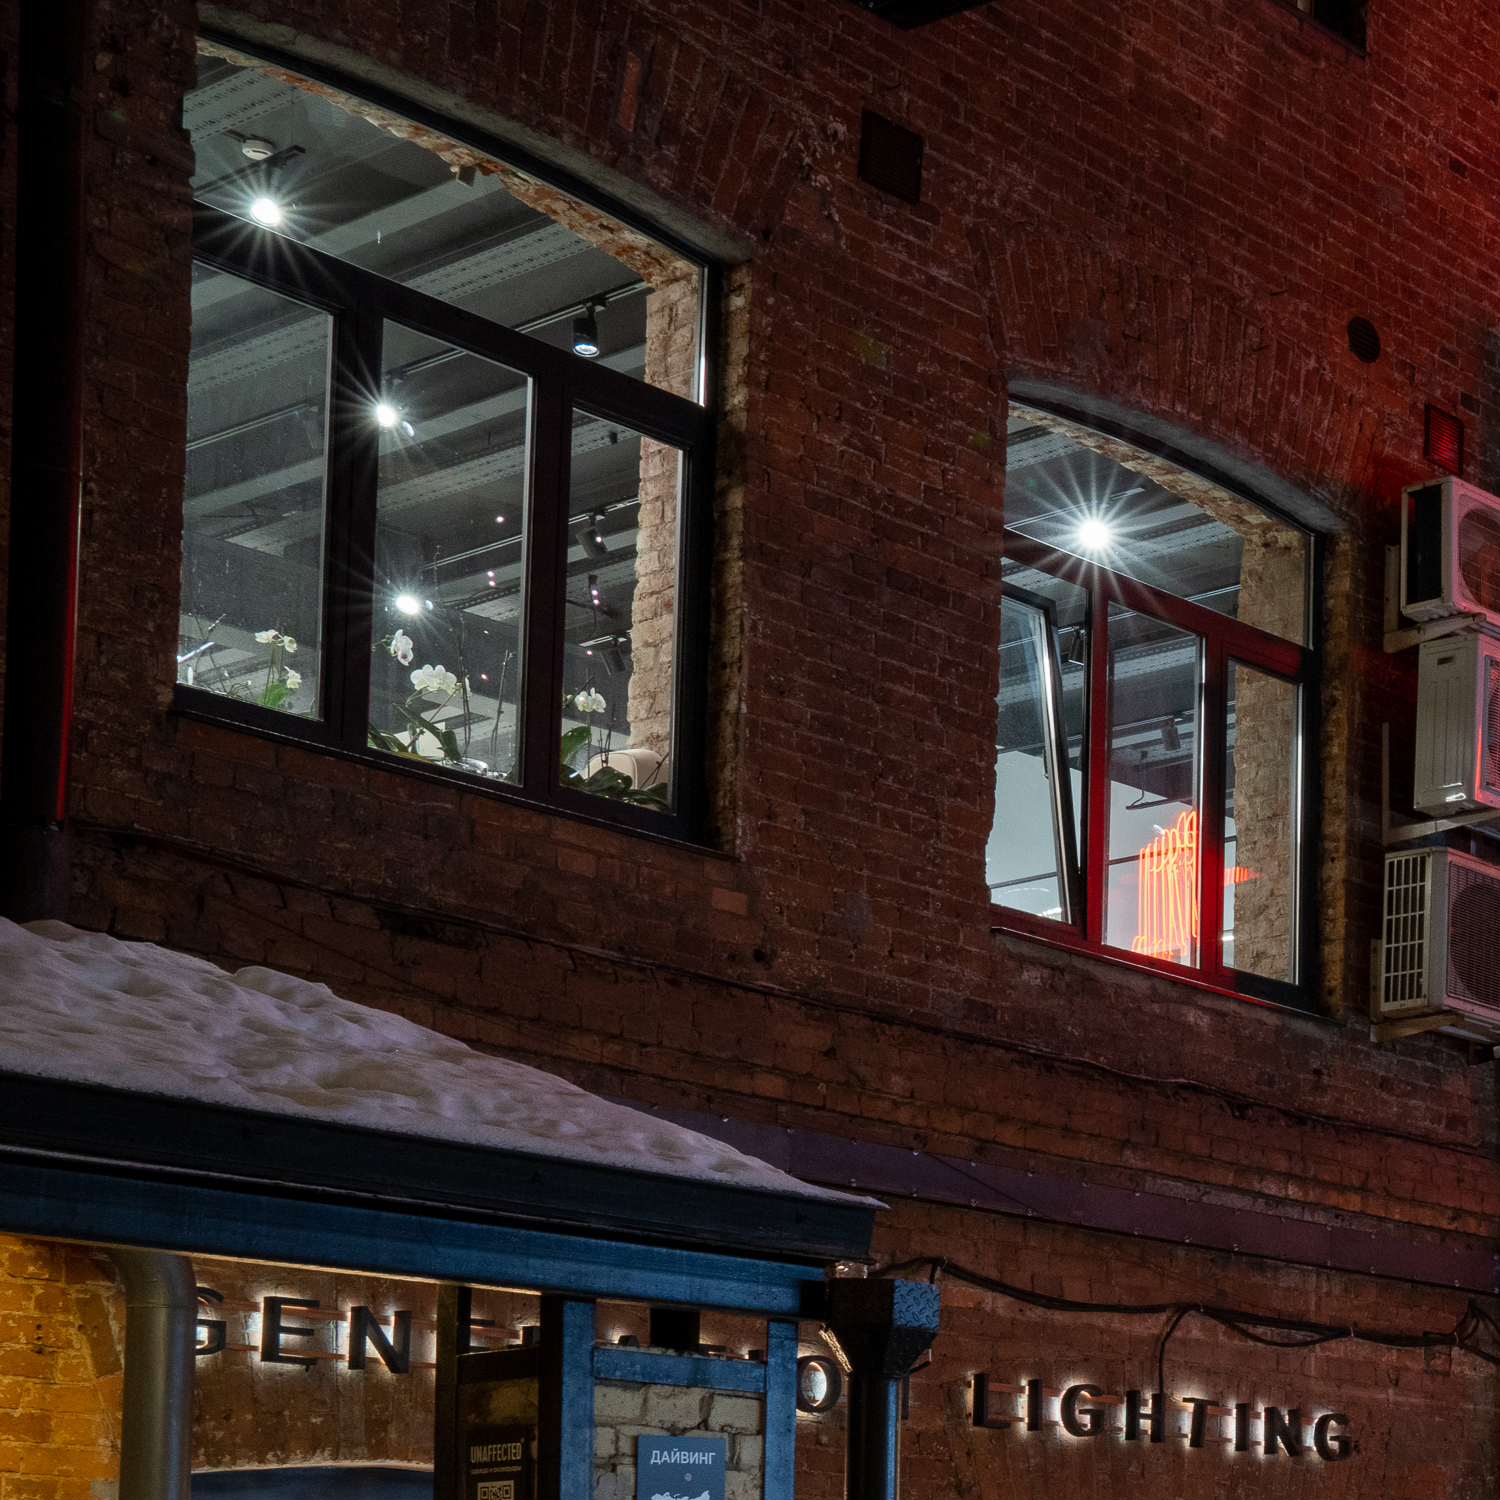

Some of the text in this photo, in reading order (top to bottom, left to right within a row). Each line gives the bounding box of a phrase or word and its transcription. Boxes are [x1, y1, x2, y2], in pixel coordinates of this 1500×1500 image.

[971, 1372, 1357, 1462] LIGHTING
[470, 1442, 522, 1463] UNAFFECTED
[650, 1448, 716, 1465] ДАЙВИНГ
